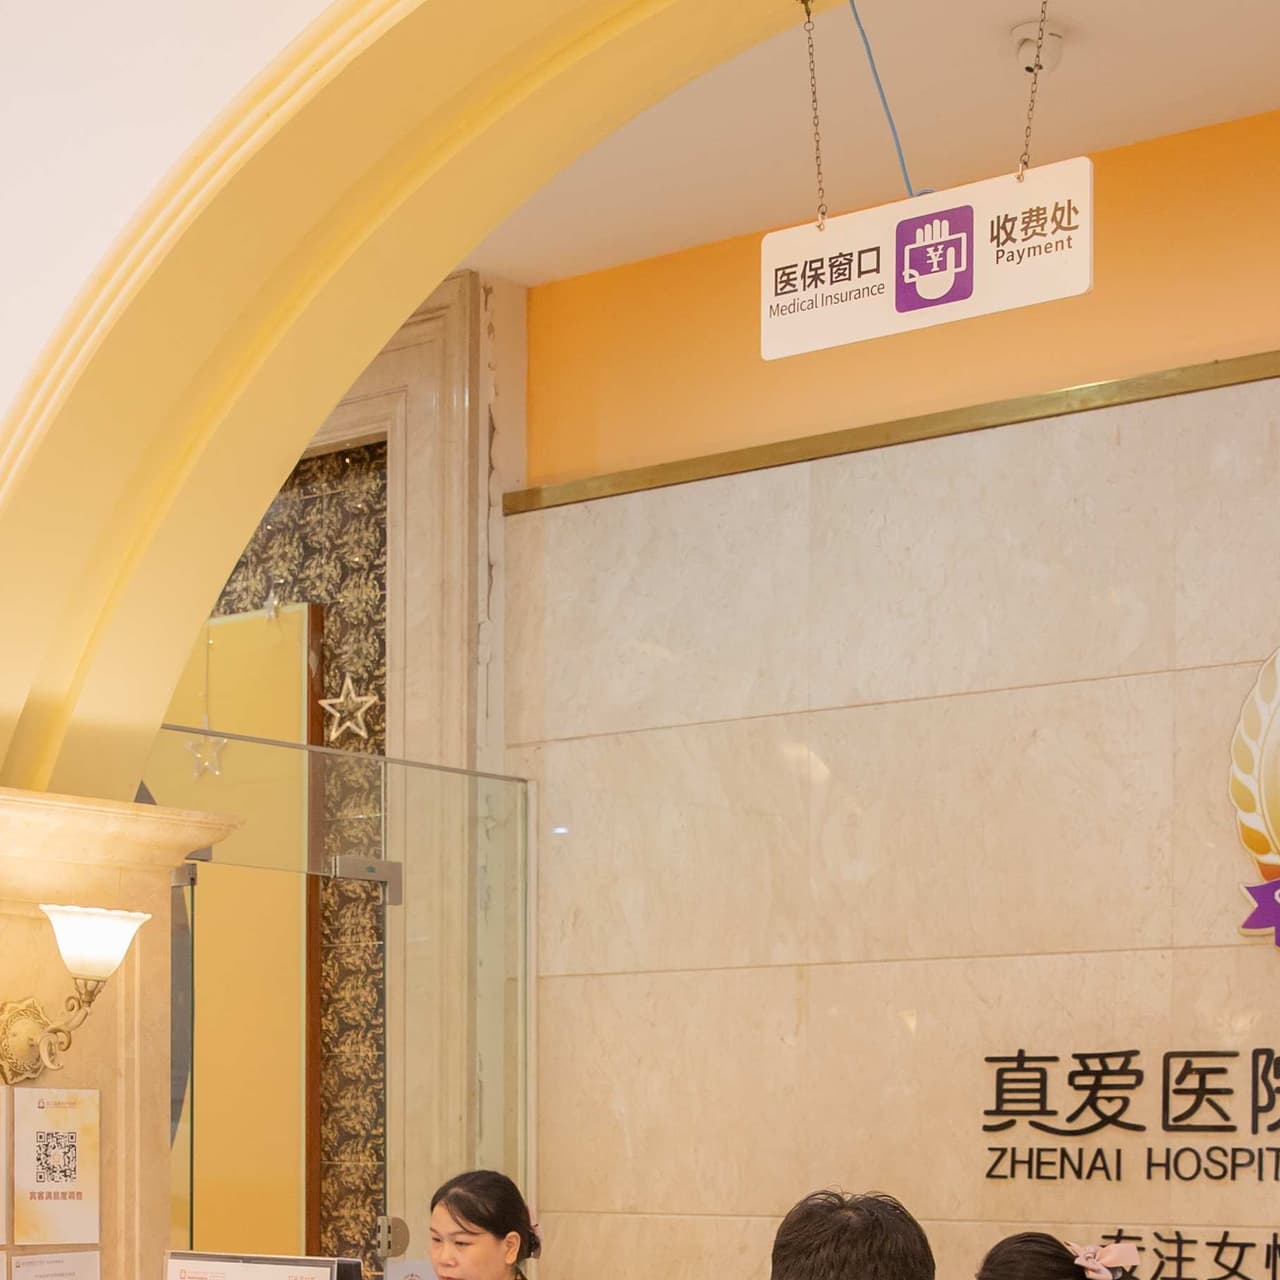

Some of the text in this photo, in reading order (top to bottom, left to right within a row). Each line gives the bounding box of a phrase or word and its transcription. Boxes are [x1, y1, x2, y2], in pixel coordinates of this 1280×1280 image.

[989, 199, 1080, 249] 收费处
[995, 235, 1074, 265] Payment
[773, 245, 882, 297] 医保窗口
[768, 282, 885, 318] Medical Insurance
[985, 1147, 1123, 1181] ZHENAI
